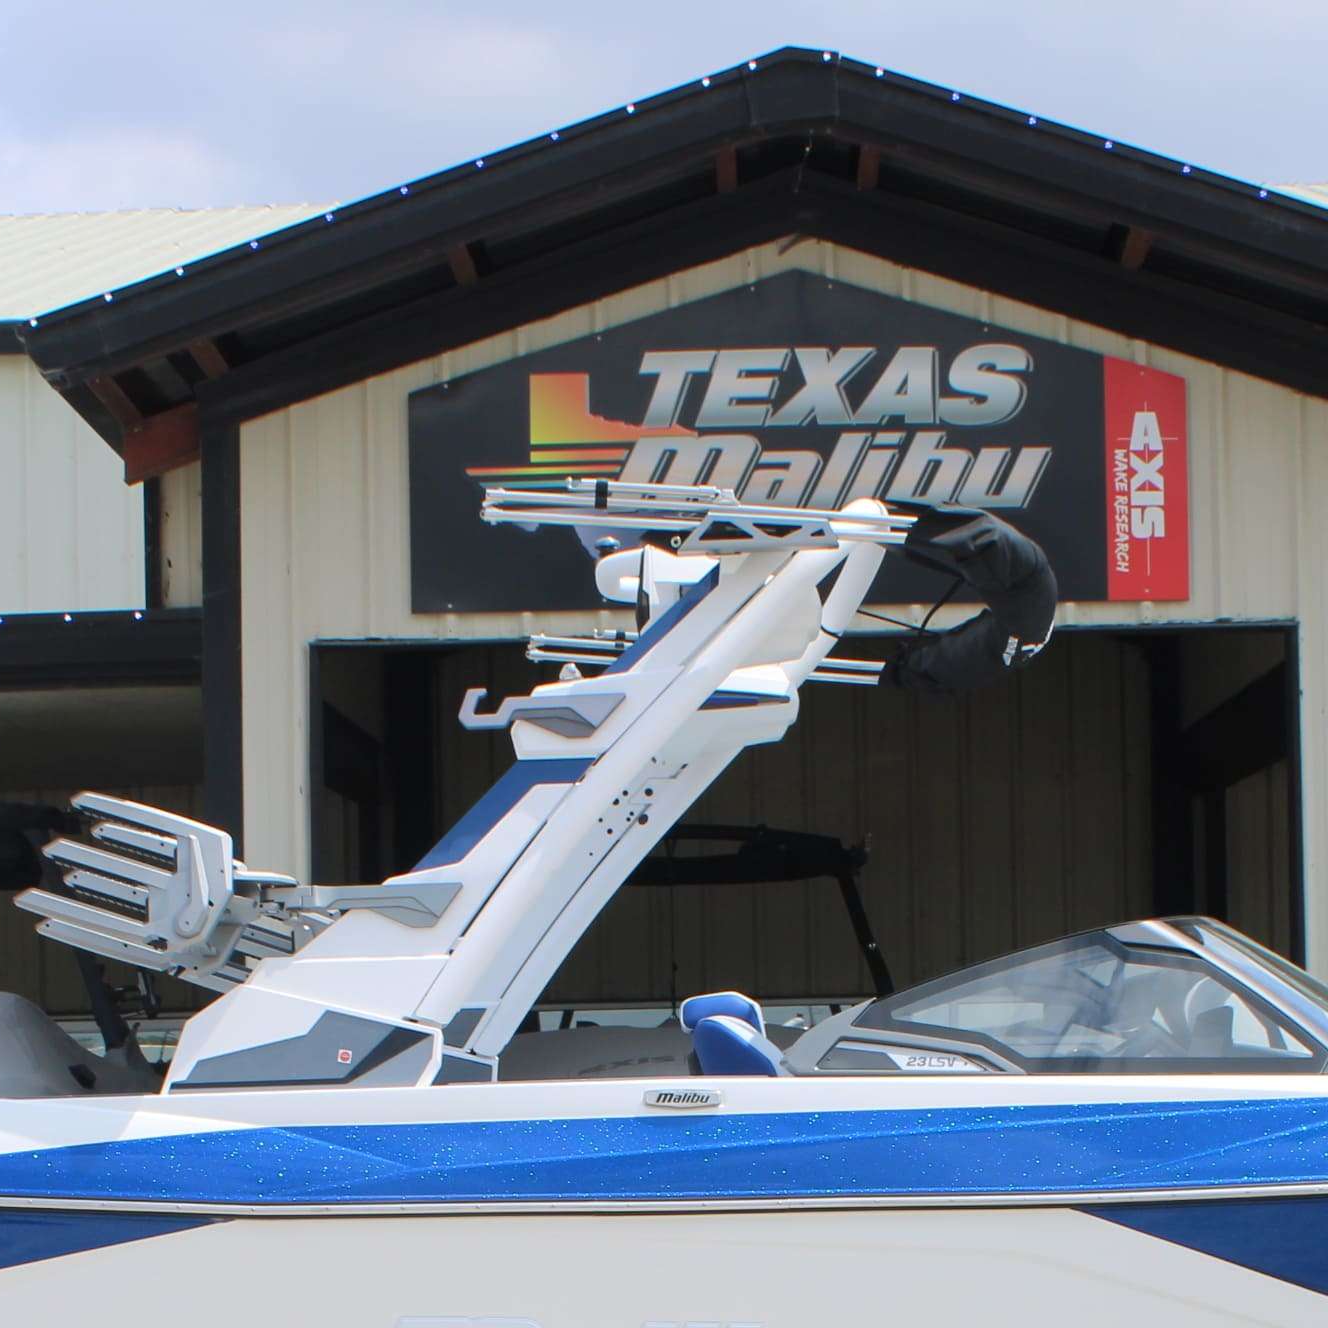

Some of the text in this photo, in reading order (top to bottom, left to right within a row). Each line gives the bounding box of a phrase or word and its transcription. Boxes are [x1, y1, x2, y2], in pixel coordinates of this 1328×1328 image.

[638, 343, 1034, 428] TEXAS
[618, 432, 1052, 509] Malibu
[1114, 449, 1130, 572] WAKE RESEARCH
[1129, 411, 1165, 538] AXIS
[656, 1092, 710, 1104] Malibu
[906, 1056, 956, 1067] 23LSV
